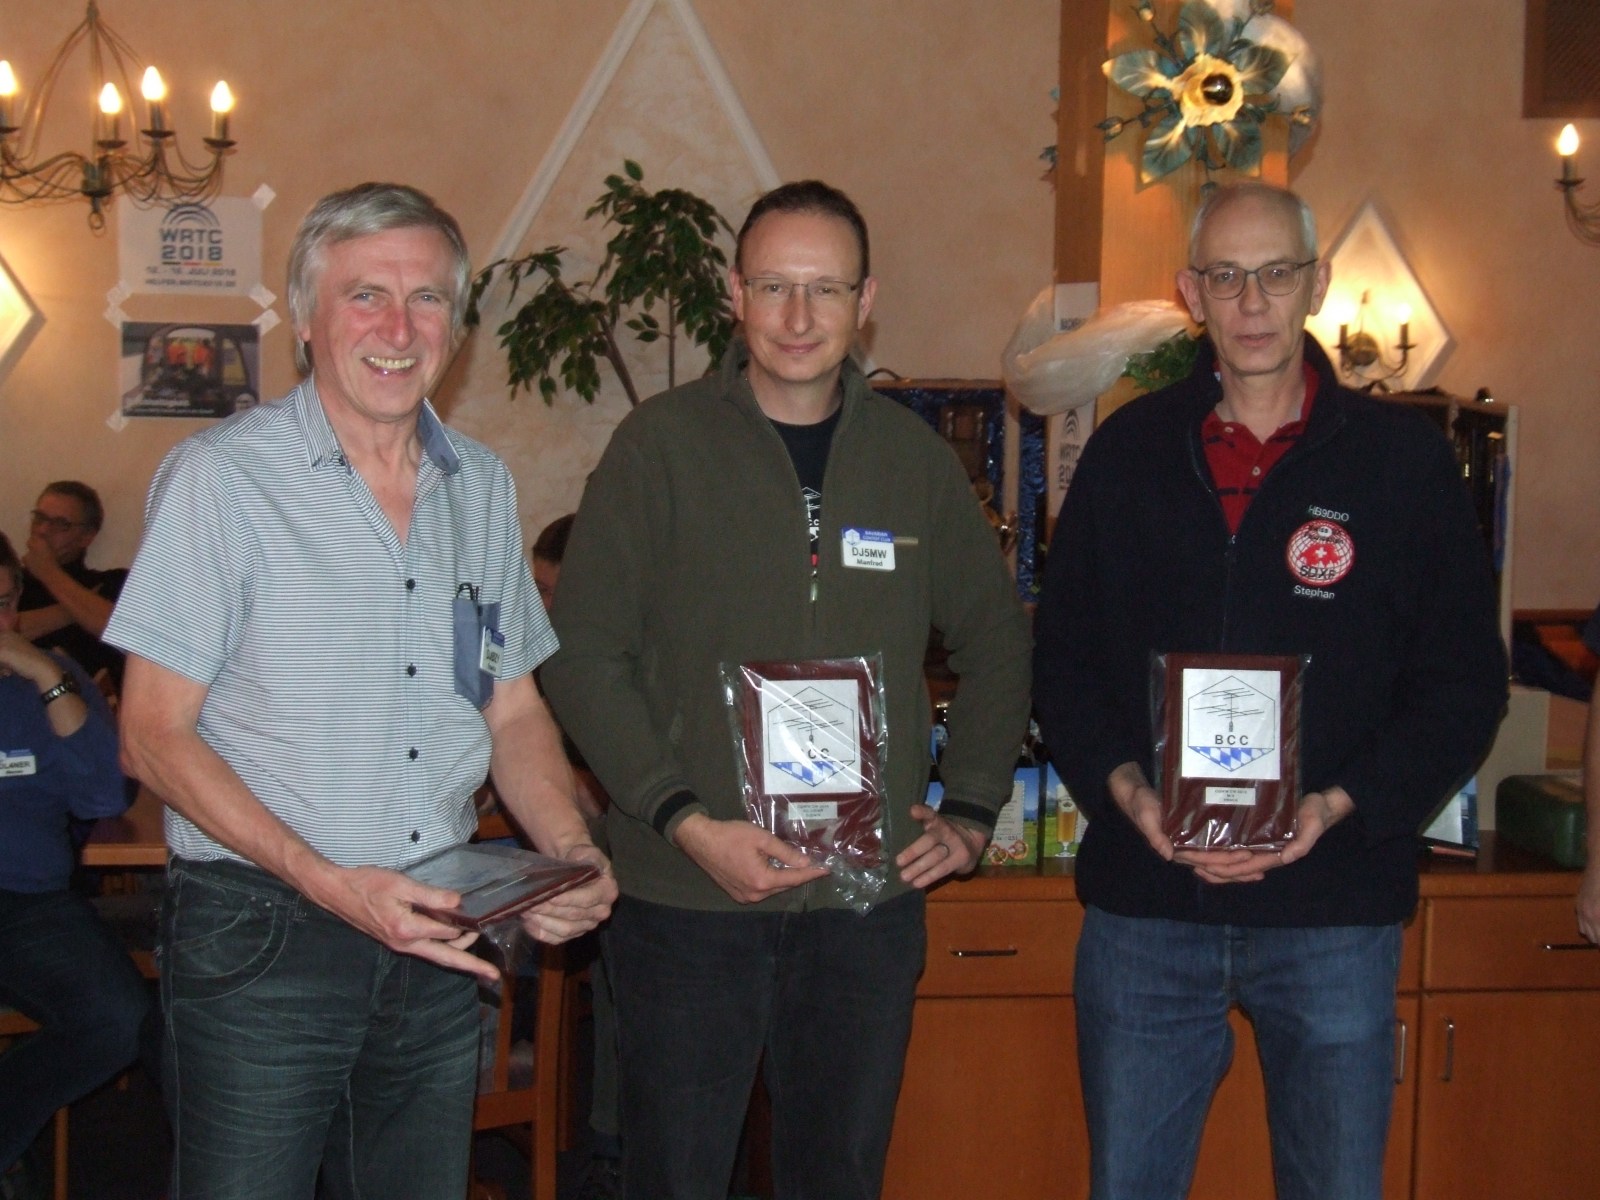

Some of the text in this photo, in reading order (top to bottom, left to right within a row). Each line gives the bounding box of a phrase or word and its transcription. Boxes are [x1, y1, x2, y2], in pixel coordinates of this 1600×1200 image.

[159, 228, 223, 244] WRTC
[161, 246, 223, 261] 2018
[1308, 505, 1350, 521] HB9DDO
[851, 547, 887, 559] DJ5MW
[856, 558, 883, 567] Manfred
[1294, 585, 1335, 600] Stephan
[1214, 734, 1249, 746] BCC
